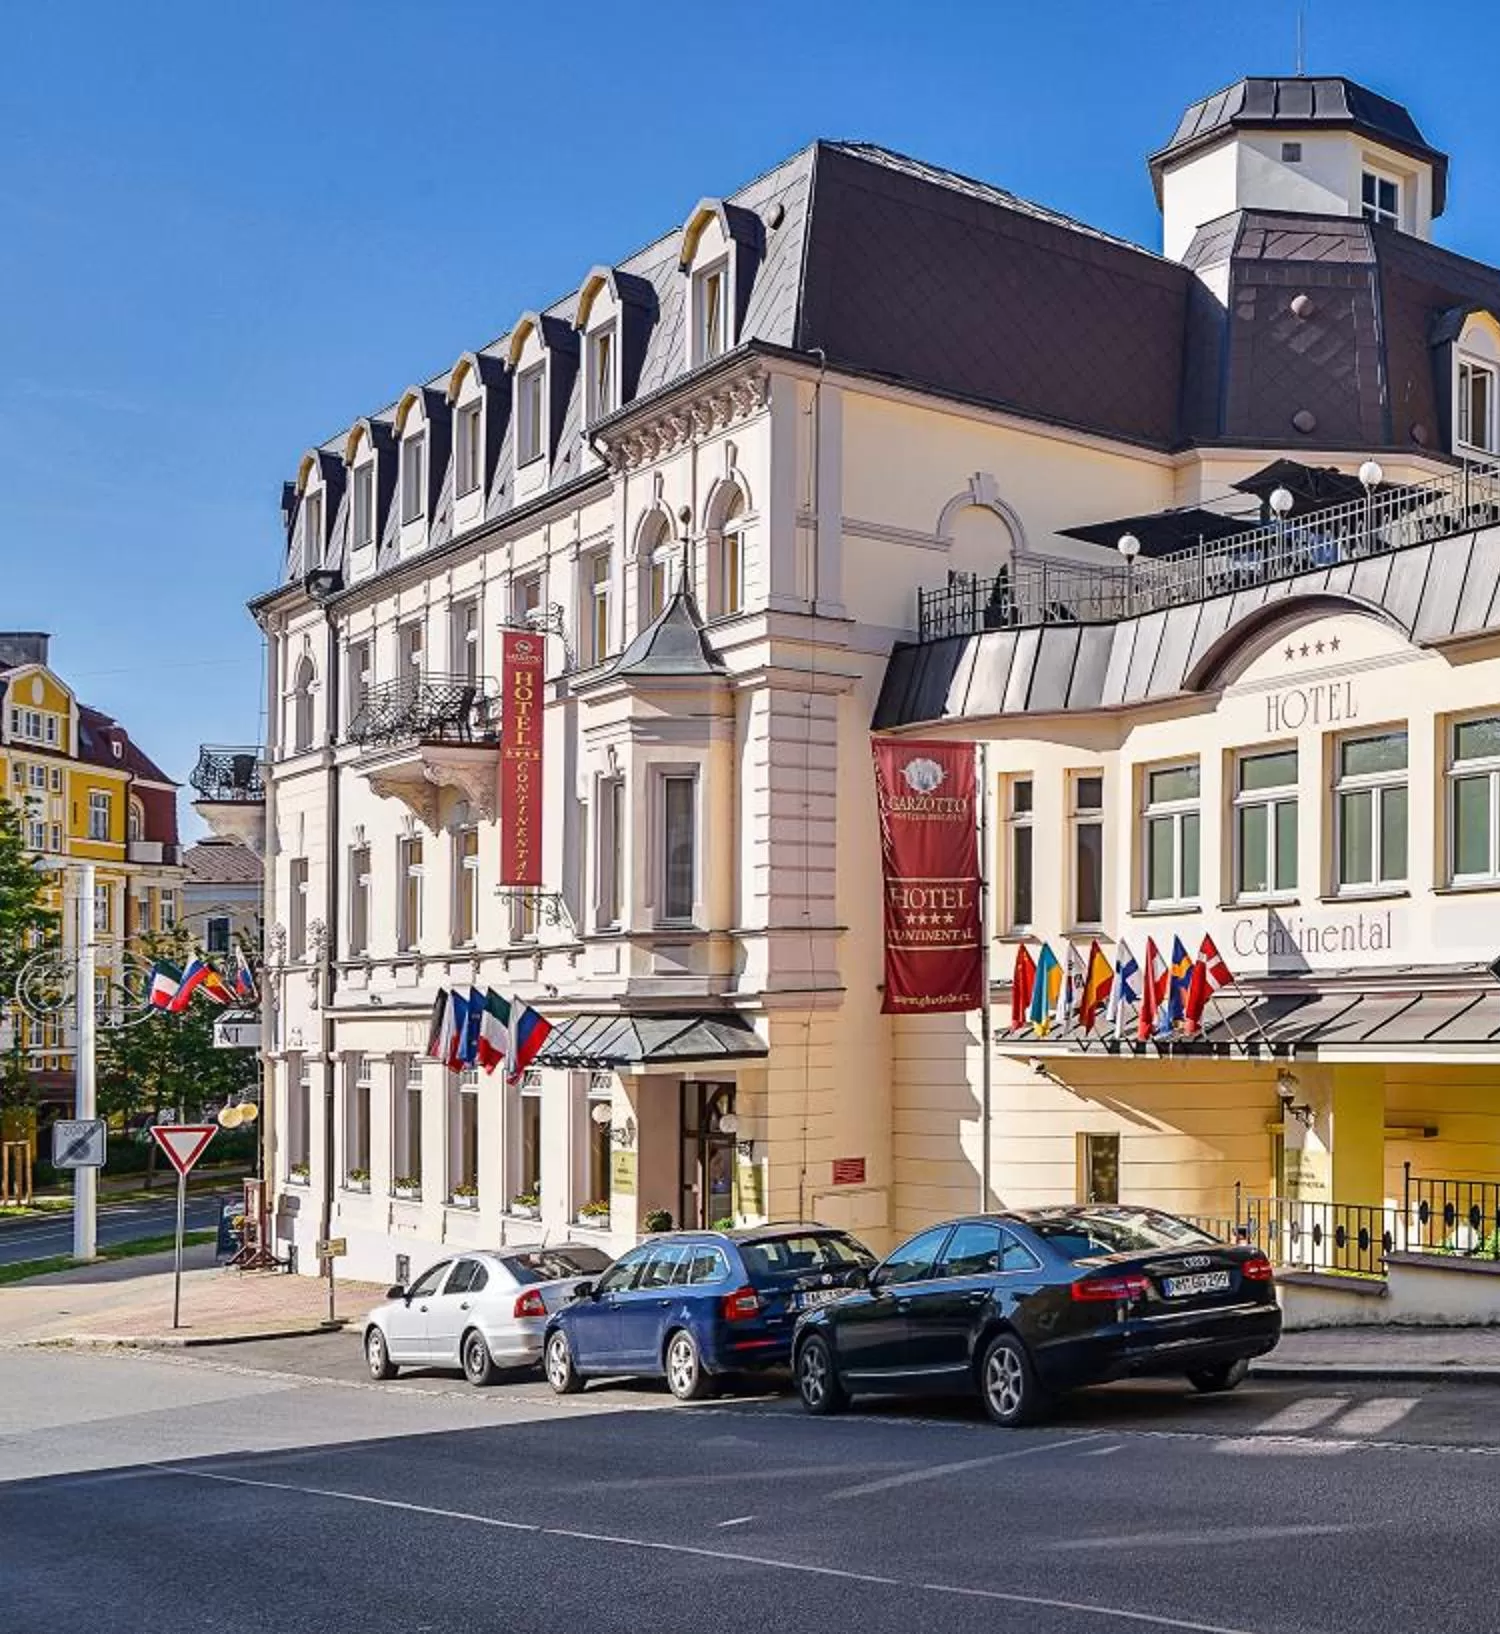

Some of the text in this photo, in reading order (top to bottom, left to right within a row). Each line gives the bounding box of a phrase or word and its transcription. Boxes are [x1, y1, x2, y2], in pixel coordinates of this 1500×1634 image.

[514, 671, 533, 746] HOTEL
[1265, 680, 1358, 732] HOTEL
[889, 795, 967, 813] GARZOTTO
[889, 887, 973, 909] HOTEL
[1233, 911, 1392, 957] Continental
